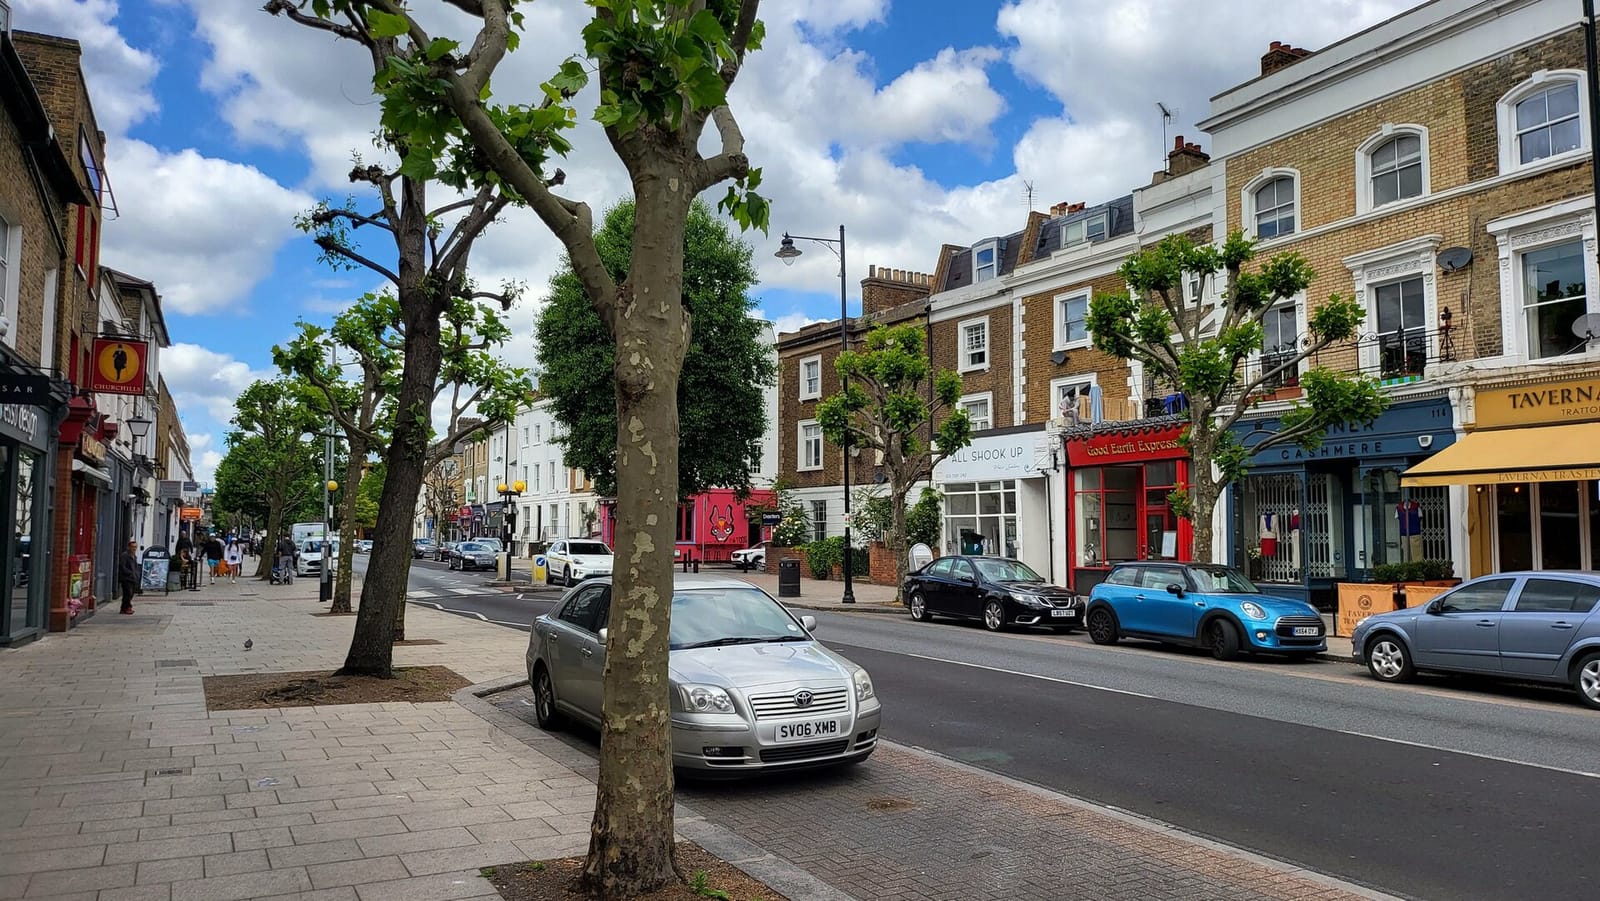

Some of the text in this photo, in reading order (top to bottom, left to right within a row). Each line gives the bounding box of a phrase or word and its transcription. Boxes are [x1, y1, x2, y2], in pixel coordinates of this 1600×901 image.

[94, 383, 142, 392] CHURCHILLS
[19, 404, 38, 441] design
[952, 446, 1023, 463] ALL SHOOK UP
[1087, 439, 1178, 456] Good Earth Express
[1281, 442, 1382, 460] CASHMERE
[1498, 471, 1548, 481] TAVERNA
[781, 720, 837, 738] SV06 XMB
